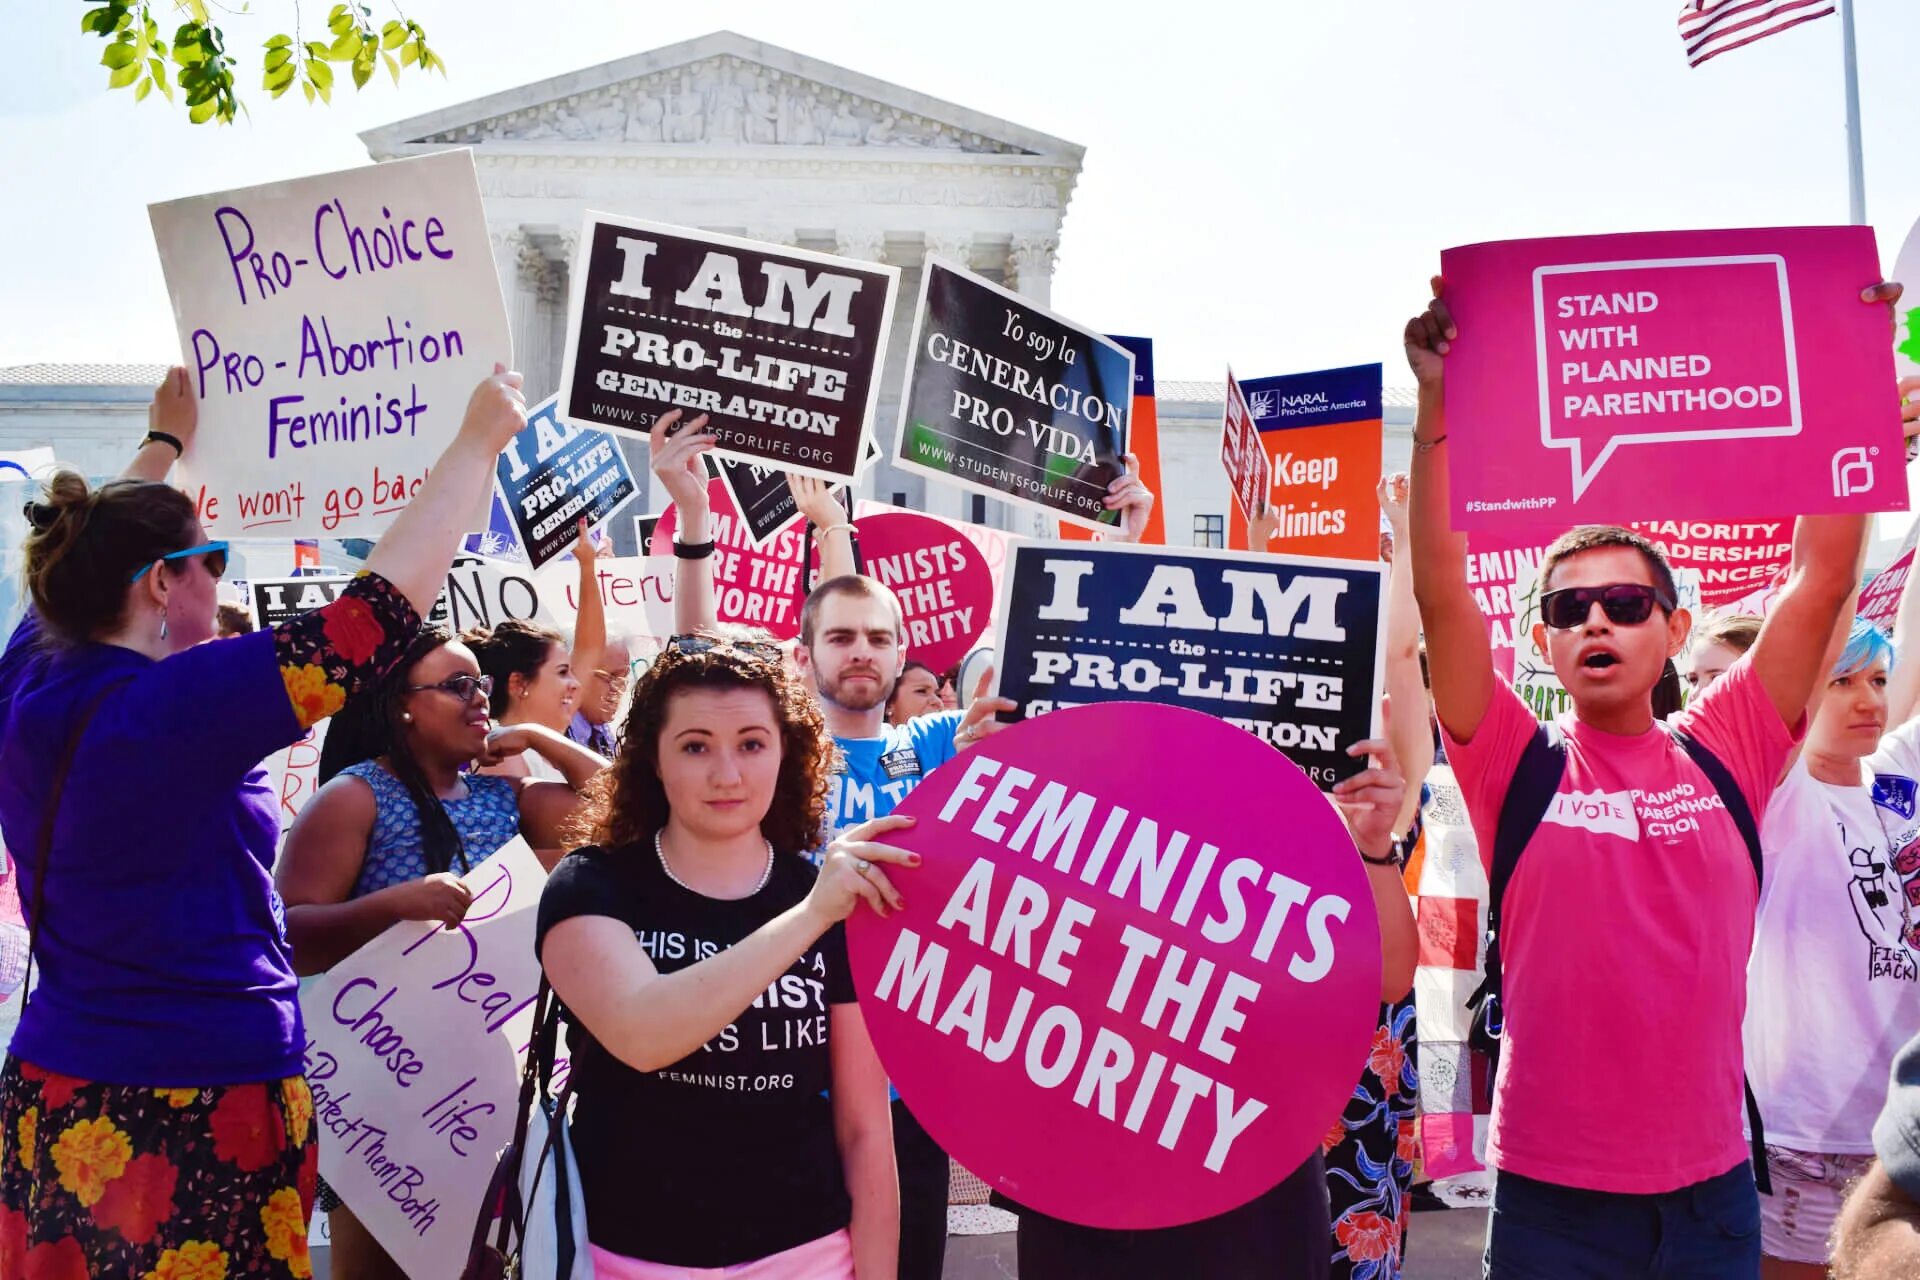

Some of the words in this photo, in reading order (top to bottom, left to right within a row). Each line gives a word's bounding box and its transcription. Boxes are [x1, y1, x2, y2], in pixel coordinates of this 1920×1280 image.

[609, 236, 658, 300] I
[675, 251, 863, 338] AM
[1557, 290, 1659, 319] STAND
[712, 322, 743, 340] the
[1002, 309, 1024, 342] Yo
[1027, 331, 1055, 362] soy
[1059, 336, 1076, 366] la
[1559, 325, 1639, 352] WITH
[600, 325, 849, 402] PRO-LIFE
[928, 332, 1122, 432] GENERACION
[1562, 354, 1712, 385] PLANNED
[269, 384, 428, 460] Feminist
[595, 369, 840, 437] GENERATION
[1282, 391, 1328, 407] NARAL
[1330, 400, 1366, 411] America
[1563, 385, 1783, 418] PARENTHOOD
[950, 390, 1100, 468] PRO-VIDA
[238, 480, 305, 519] won't
[322, 486, 363, 530] go
[372, 466, 429, 506] bac
[520, 440, 613, 520] PRO-LIFE
[1274, 452, 1338, 490] Keep
[532, 464, 621, 541] GENERATION
[1466, 497, 1556, 513] #StandwithPP
[448, 571, 539, 631] NO
[750, 558, 799, 594] THE
[897, 579, 956, 617] THE
[1037, 559, 1095, 622] I
[1119, 565, 1349, 642] AM
[1168, 639, 1206, 657] the
[1028, 650, 1344, 712] PRO-LIFE
[1572, 800, 1625, 820] VOTE
[938, 755, 1351, 983] FEMINISTS
[812, 952, 826, 977] A
[938, 857, 1096, 985] ARE
[1106, 924, 1262, 1064] THE
[1874, 963, 1914, 981] BACK
[332, 976, 425, 1088] Choose
[762, 1016, 827, 1051] LIKE
[873, 928, 1268, 1174] MAJORITY
[658, 1071, 794, 1092] FEMINIST.ORG
[421, 1077, 496, 1158] life
